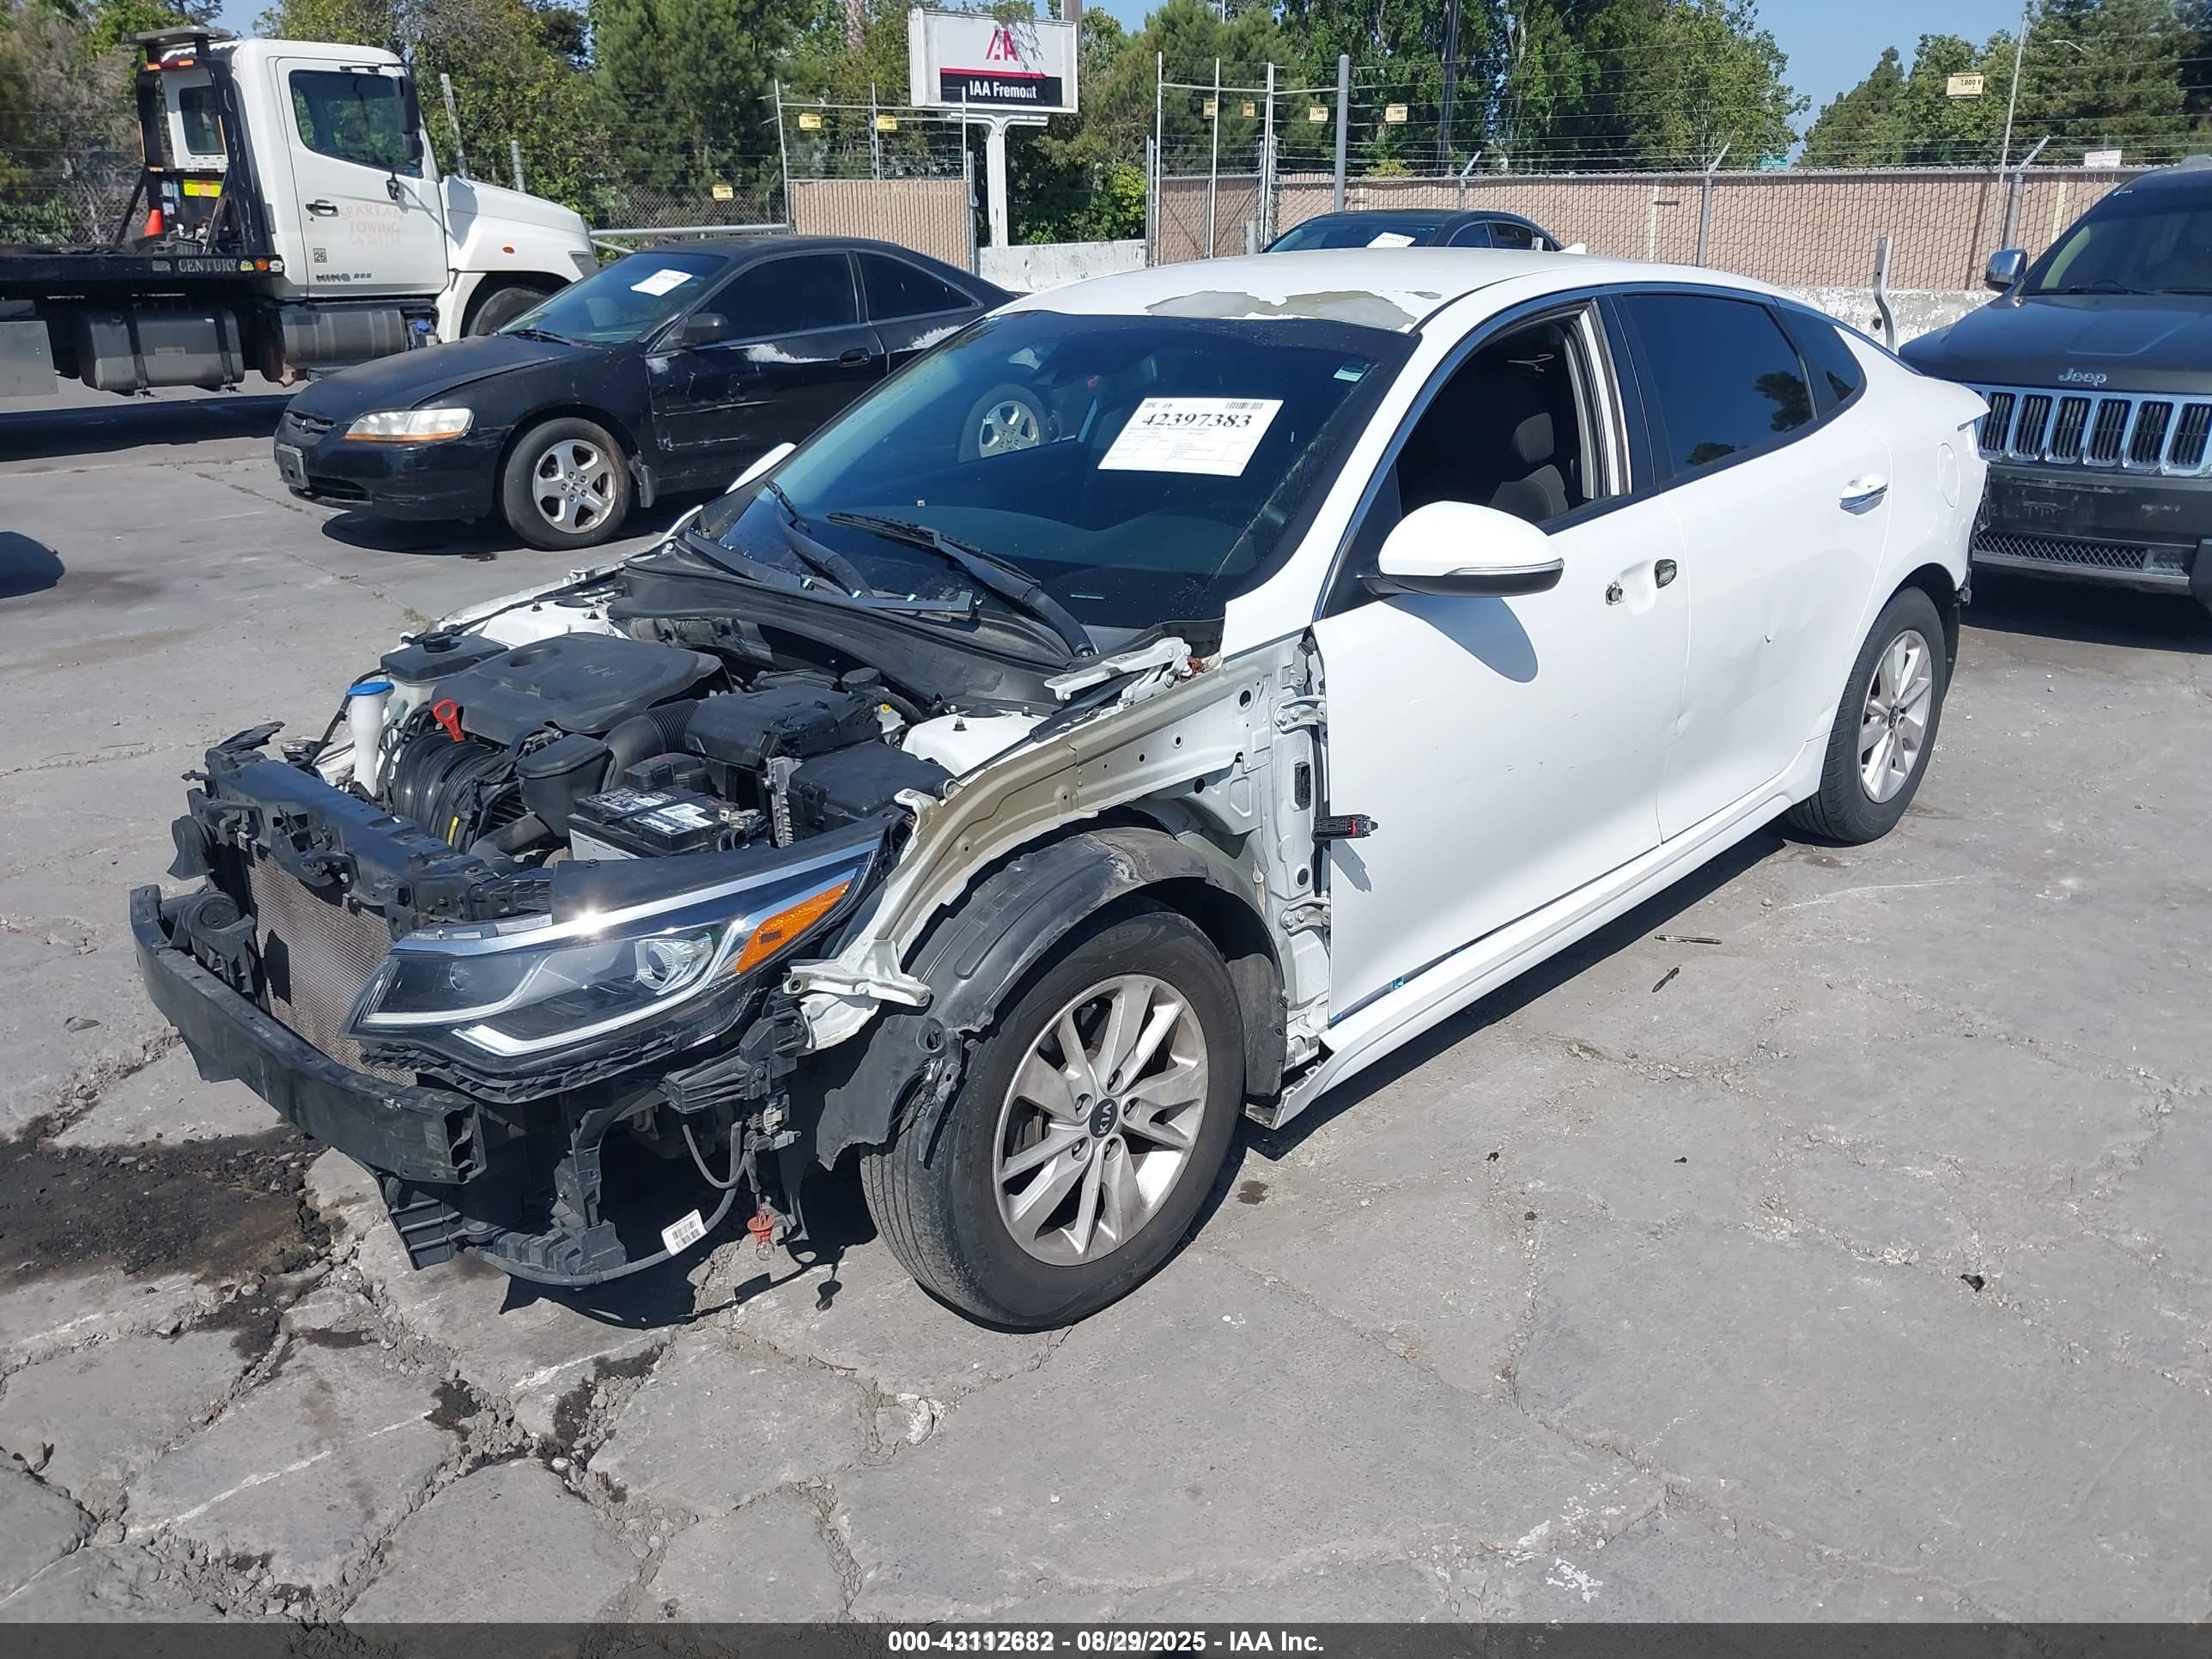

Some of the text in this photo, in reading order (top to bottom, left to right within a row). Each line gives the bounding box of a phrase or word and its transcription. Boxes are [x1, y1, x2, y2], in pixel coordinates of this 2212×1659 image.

[969, 80, 1037, 100] IAA Fremont
[340, 204, 404, 220] SPARTAN
[349, 222, 400, 234] TOWING
[178, 258, 238, 272] CENTURY
[315, 252, 326, 262] 26
[316, 273, 351, 283] HINO
[2057, 368, 2107, 387] Jeep
[1142, 412, 1253, 428] 42397383
[1097, 1103, 1113, 1134] KIA
